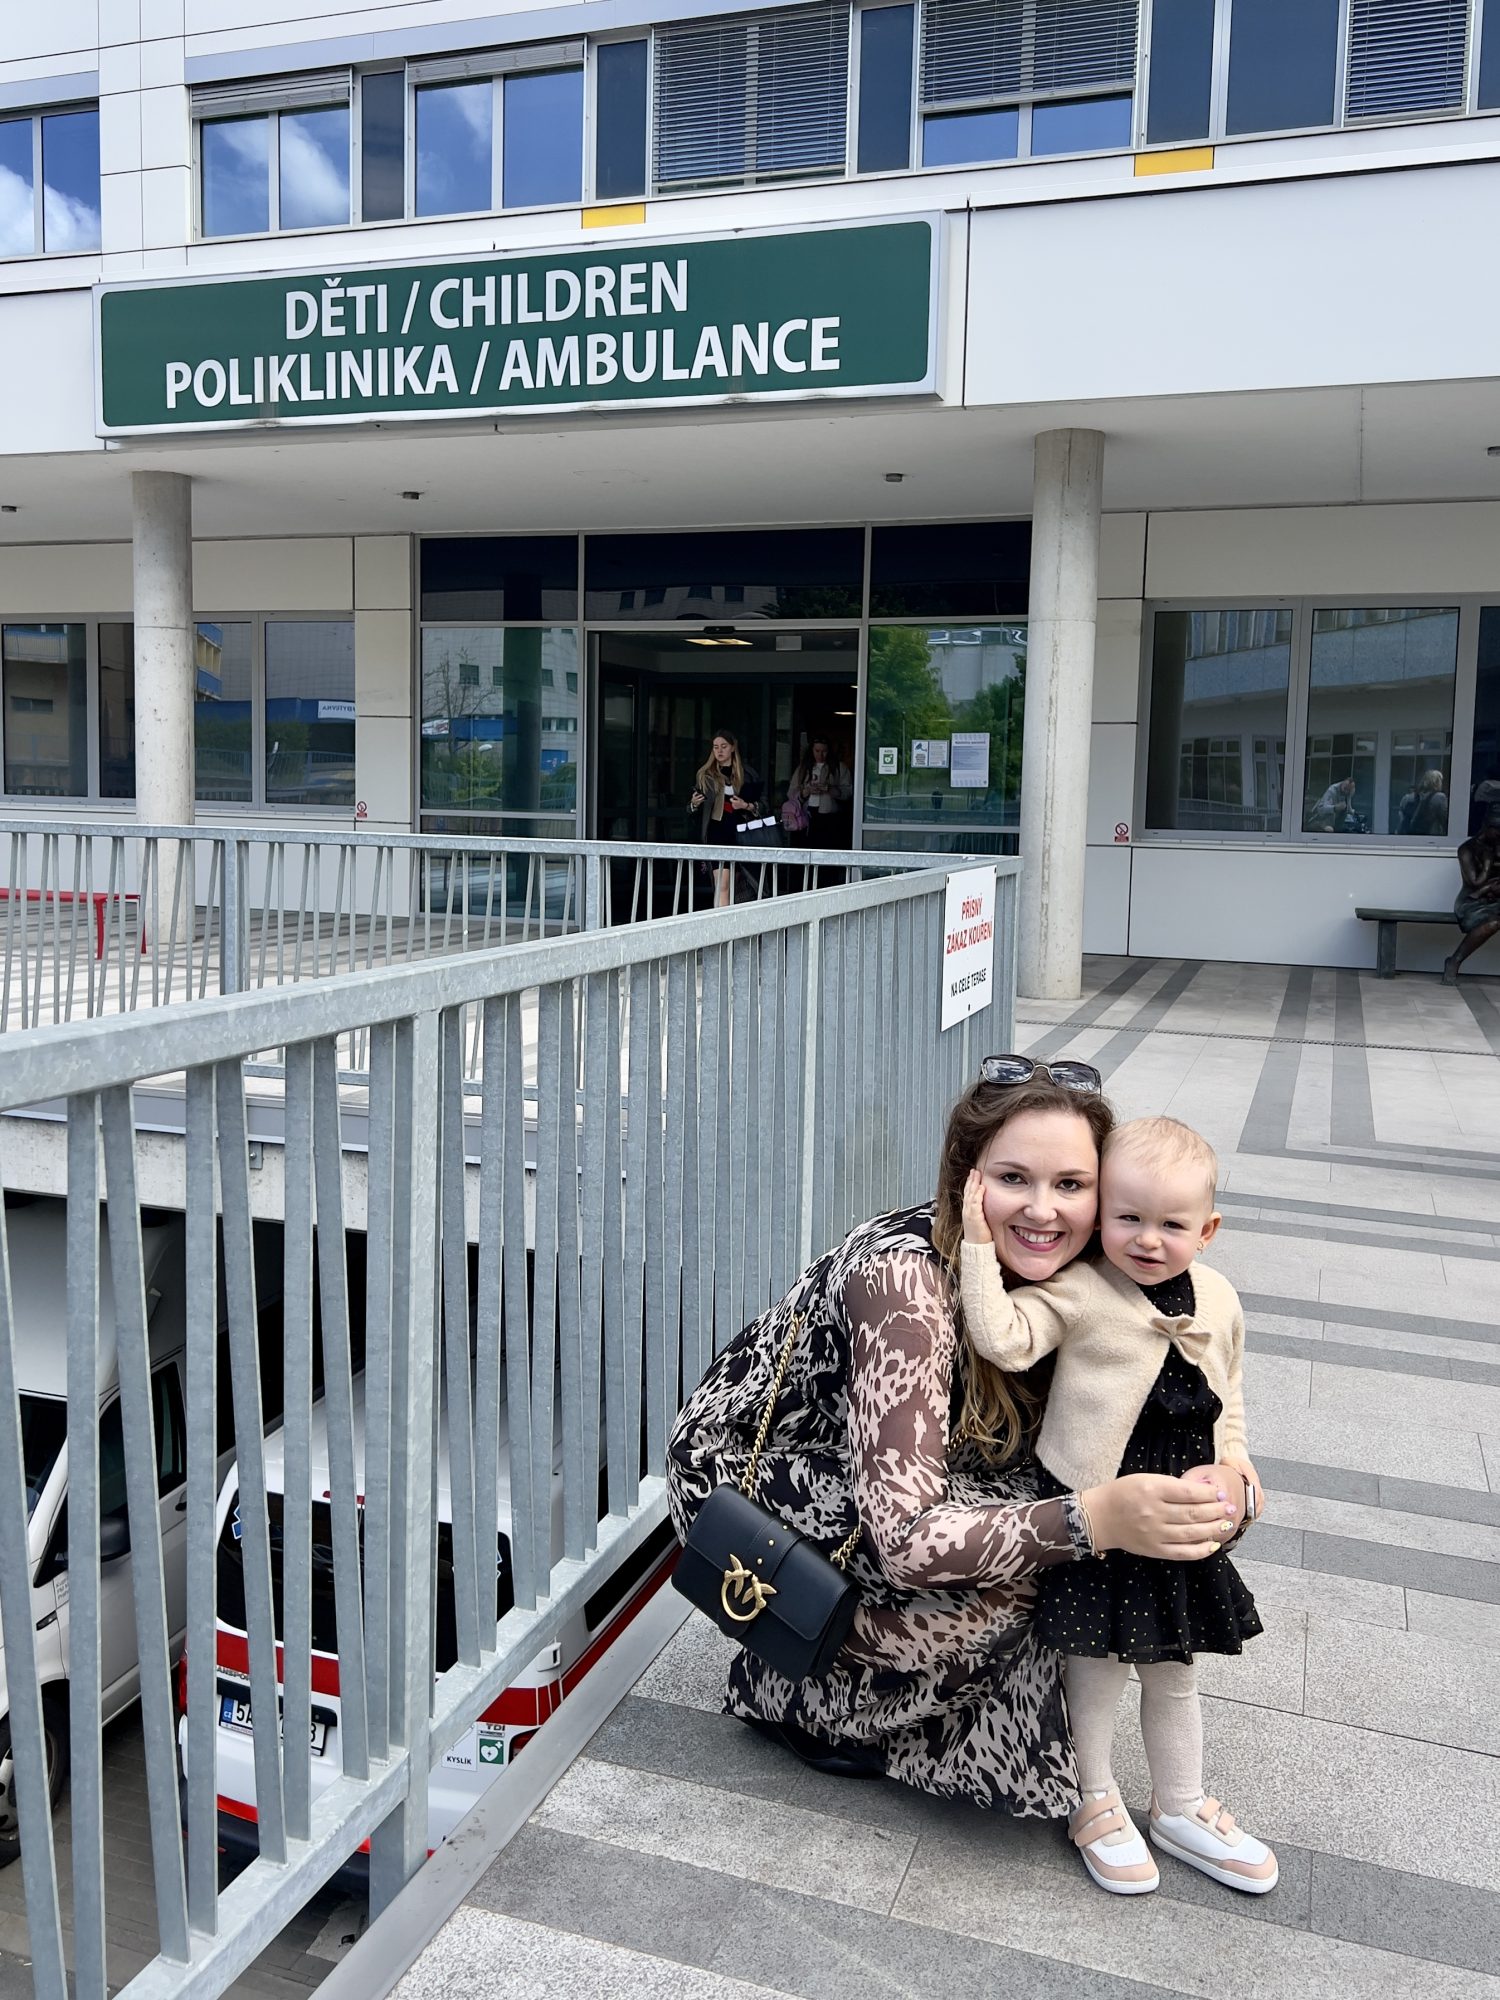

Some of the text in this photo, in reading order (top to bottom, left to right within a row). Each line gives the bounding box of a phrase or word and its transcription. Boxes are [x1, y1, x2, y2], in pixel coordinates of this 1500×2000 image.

[286, 259, 688, 340] DĚTI / CHILDREN
[166, 316, 840, 409] POLIKLINIKA / AMBULANCE
[961, 893, 983, 921] PŘÍSNÝ
[946, 916, 993, 955] ZÁKAZ KOUŘENÍ
[951, 968, 987, 997] NA CELÉ TERASE
[486, 1723, 506, 1731] TDI
[446, 1756, 472, 1765] KYSLÍK
